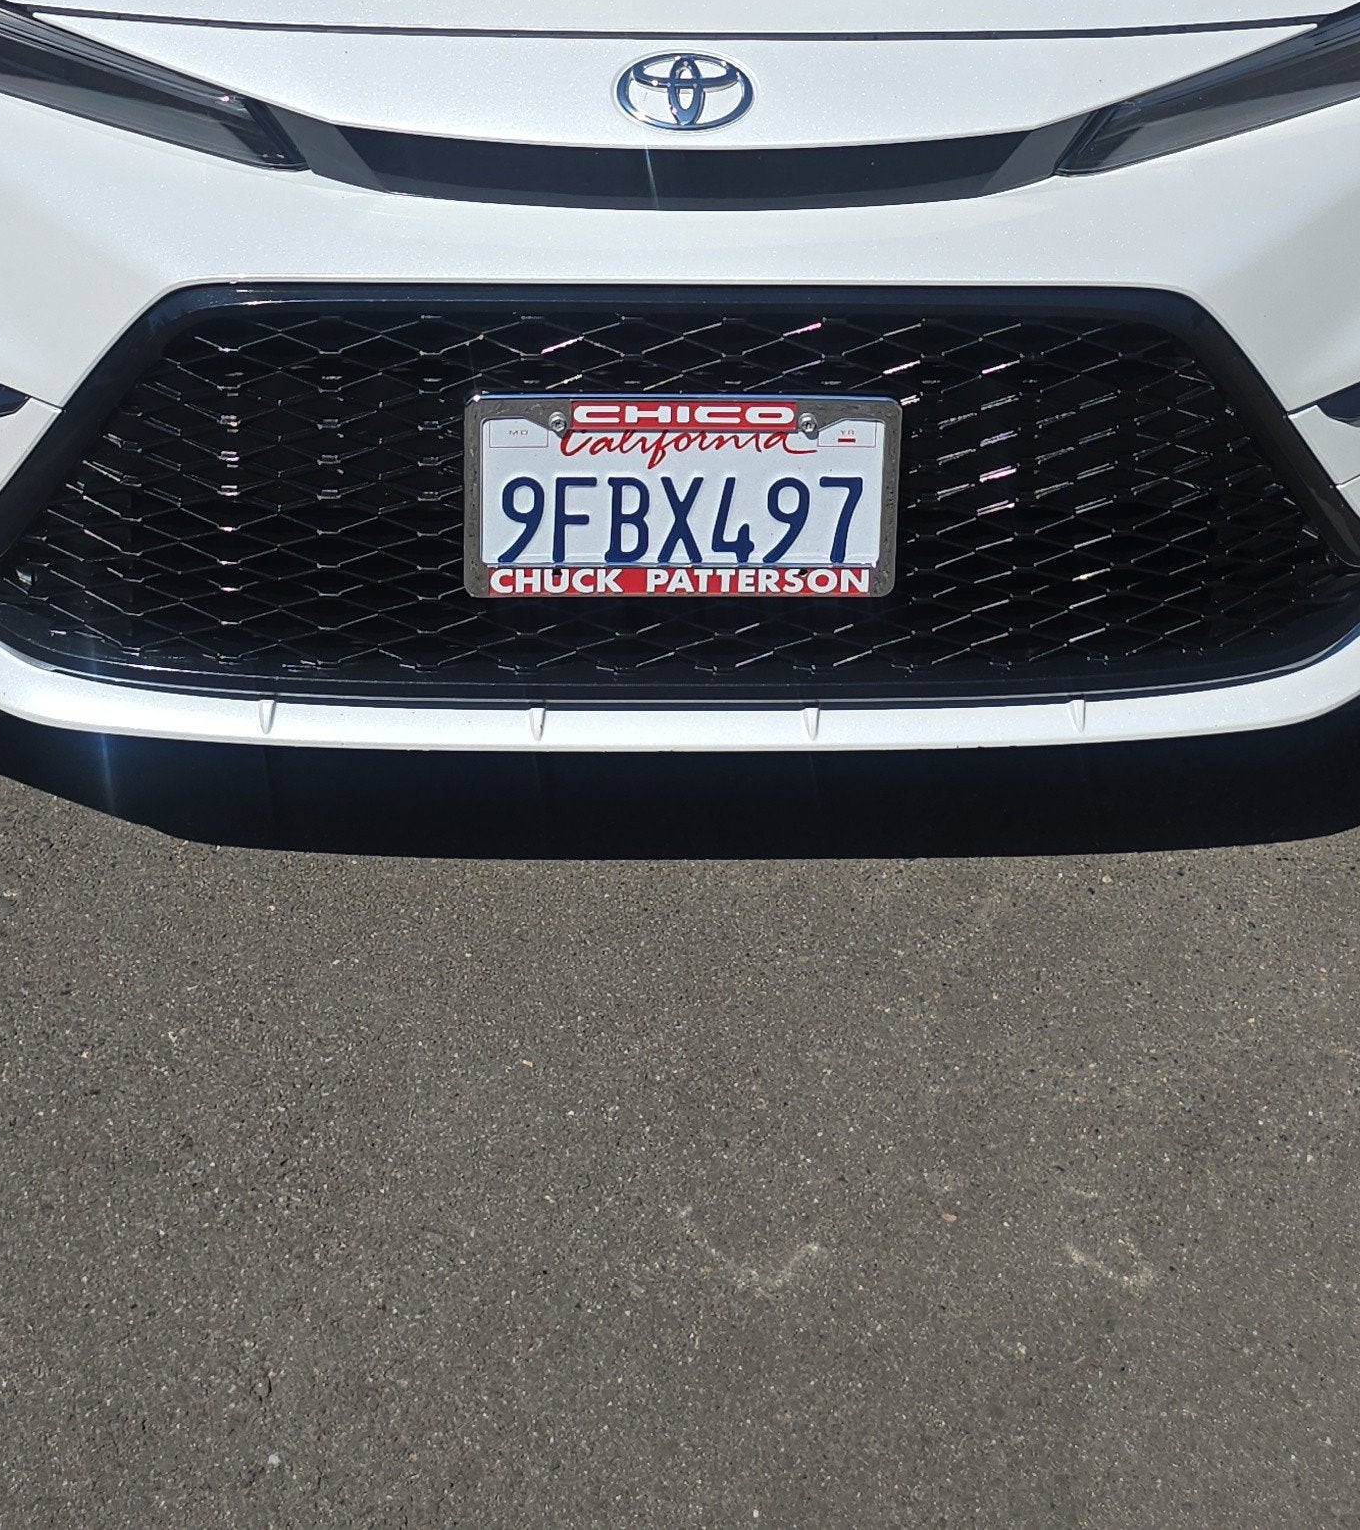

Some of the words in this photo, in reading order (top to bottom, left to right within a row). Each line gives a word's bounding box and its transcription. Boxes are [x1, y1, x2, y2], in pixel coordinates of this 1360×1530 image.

[573, 405, 795, 424] CHICO
[560, 428, 818, 470] California
[497, 476, 864, 563] 9FBX497
[490, 568, 623, 594] CHUCK
[646, 568, 870, 594] PATTERSON
